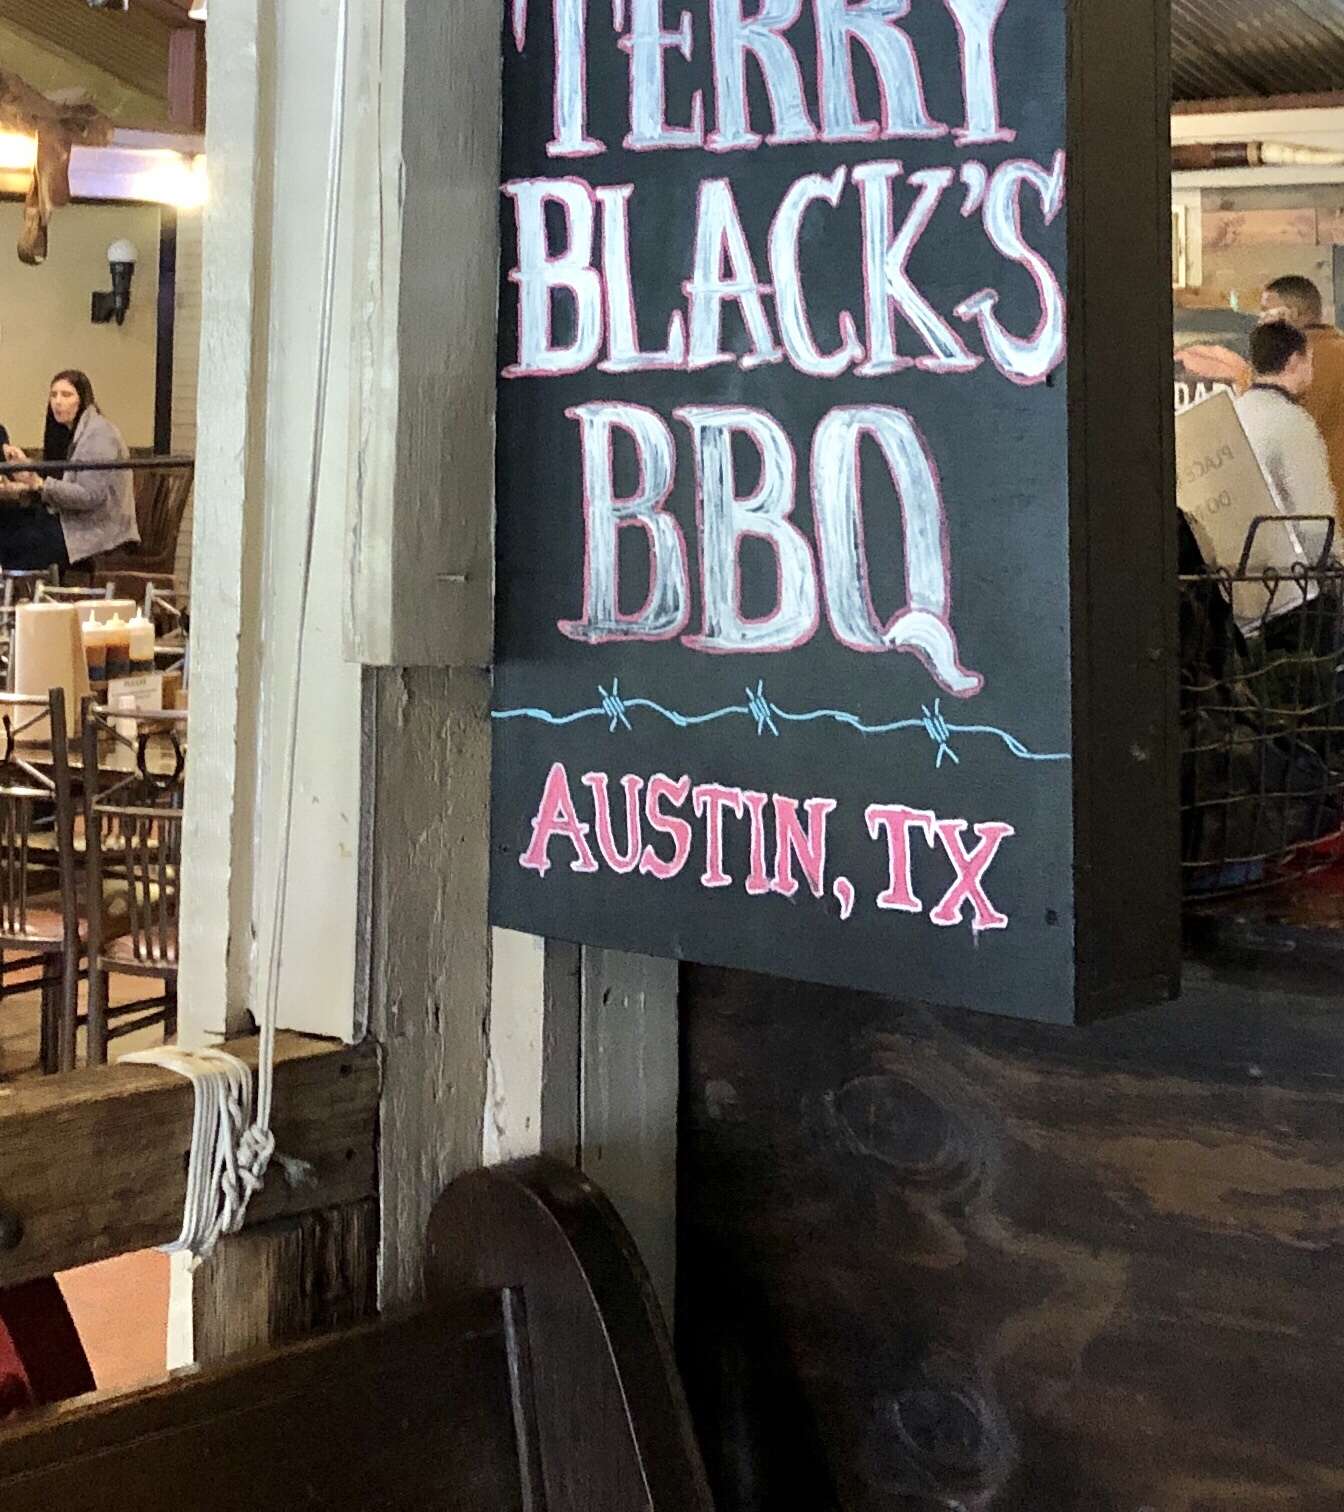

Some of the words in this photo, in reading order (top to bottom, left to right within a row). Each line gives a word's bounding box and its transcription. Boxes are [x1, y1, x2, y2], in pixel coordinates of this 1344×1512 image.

[500, 150, 1066, 385] BLACK'S
[557, 399, 985, 698] BBQ
[519, 761, 855, 920] AUSTIN,
[865, 801, 1014, 931] TX
